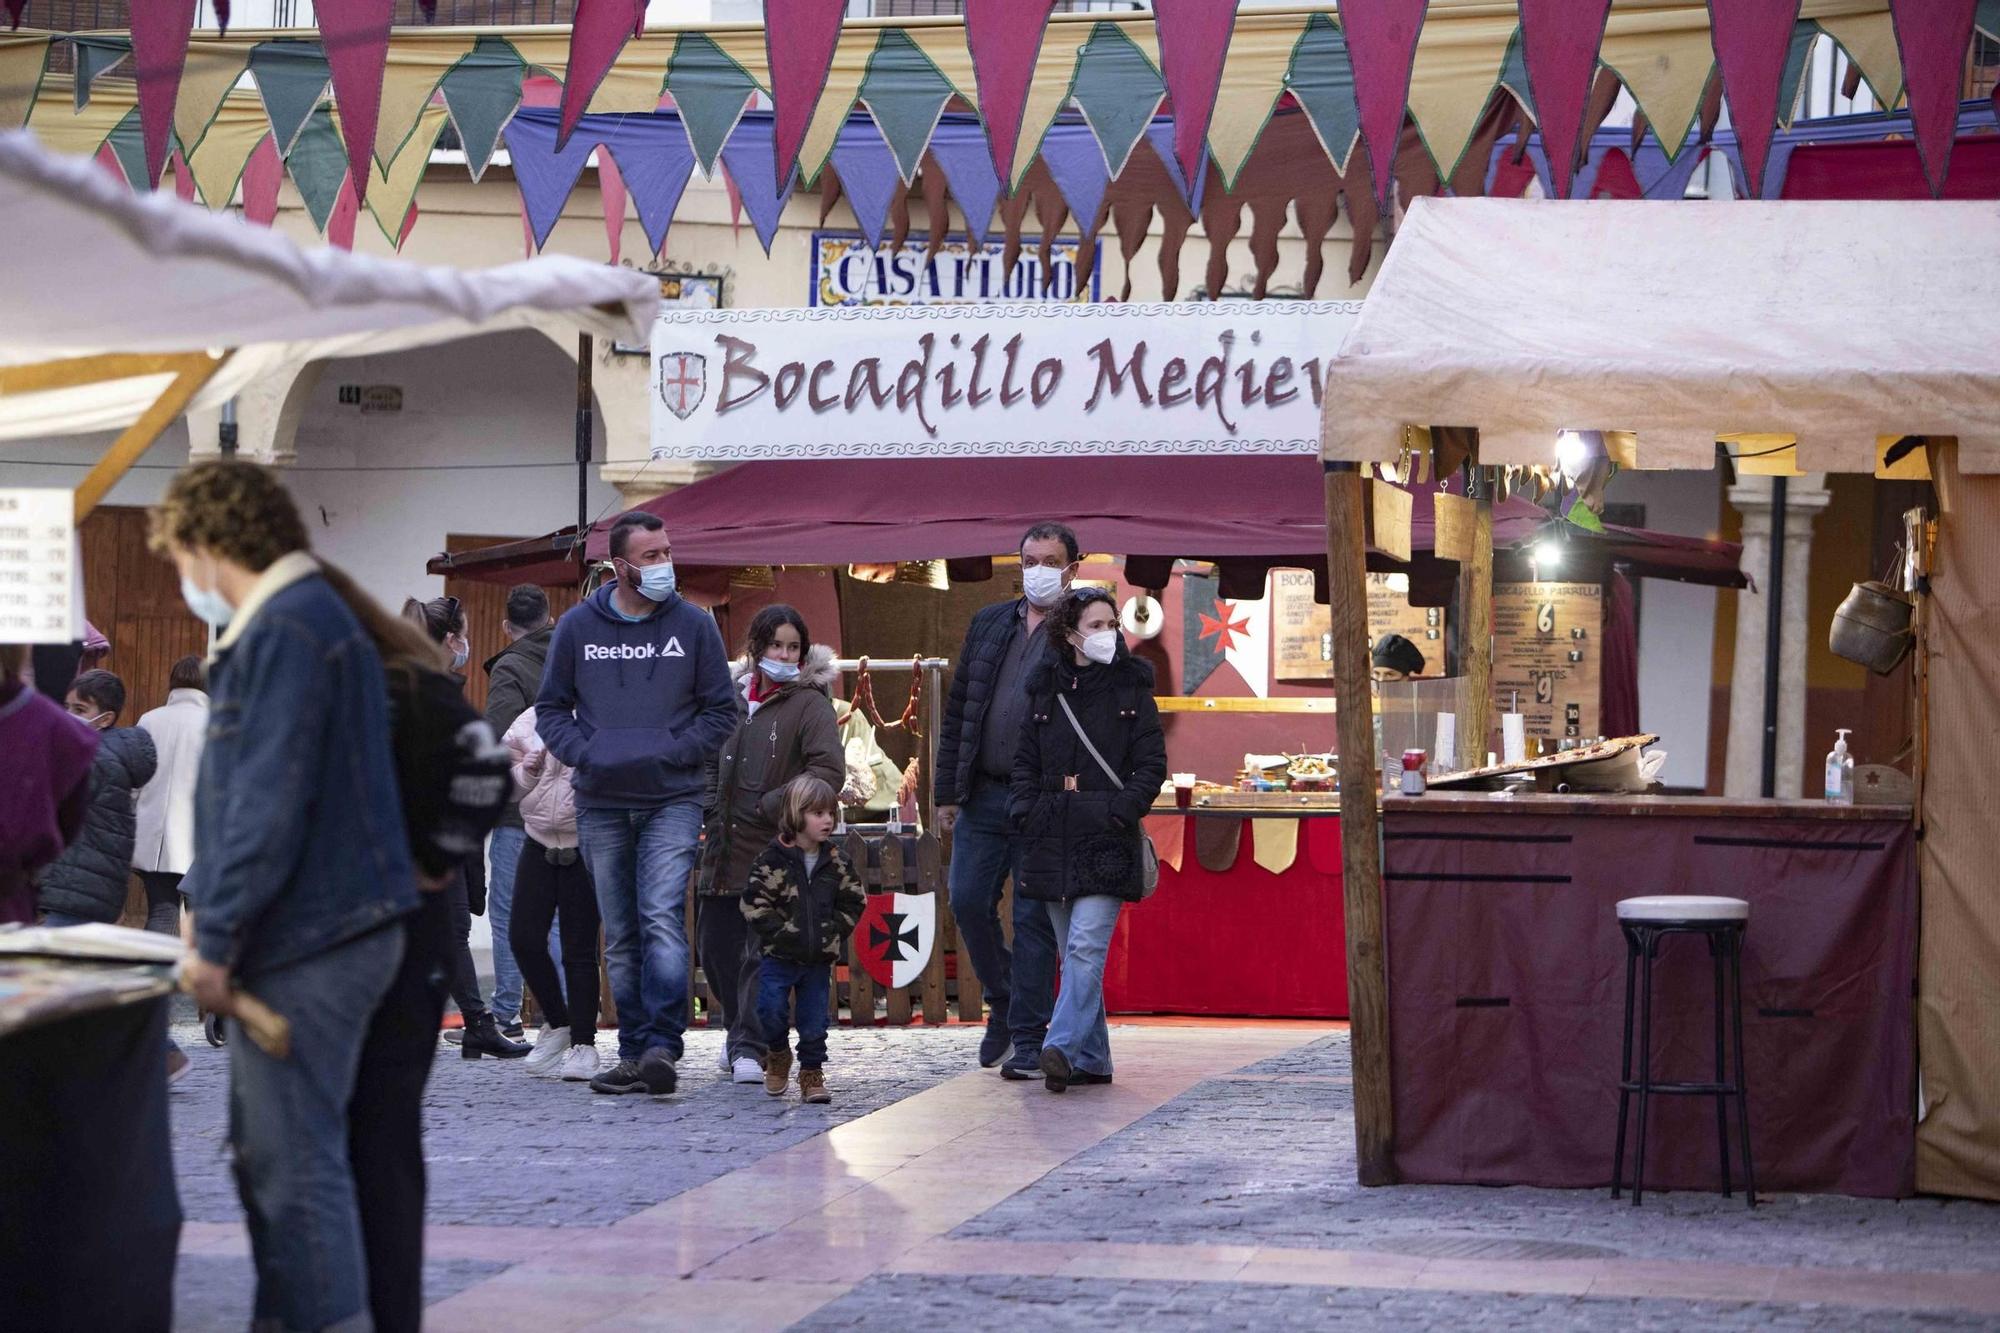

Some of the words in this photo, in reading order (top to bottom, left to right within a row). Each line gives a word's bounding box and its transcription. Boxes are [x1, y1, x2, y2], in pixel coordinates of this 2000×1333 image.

[838, 253, 942, 297] CASA
[714, 332, 1062, 434] Bocadillo
[1538, 602, 1552, 632] 6
[584, 643, 660, 660] Reebok
[1529, 669, 1566, 679] PLATOS
[1537, 676, 1551, 703] 9
[1567, 709, 1578, 719] 10
[1567, 726, 1576, 735] 3
